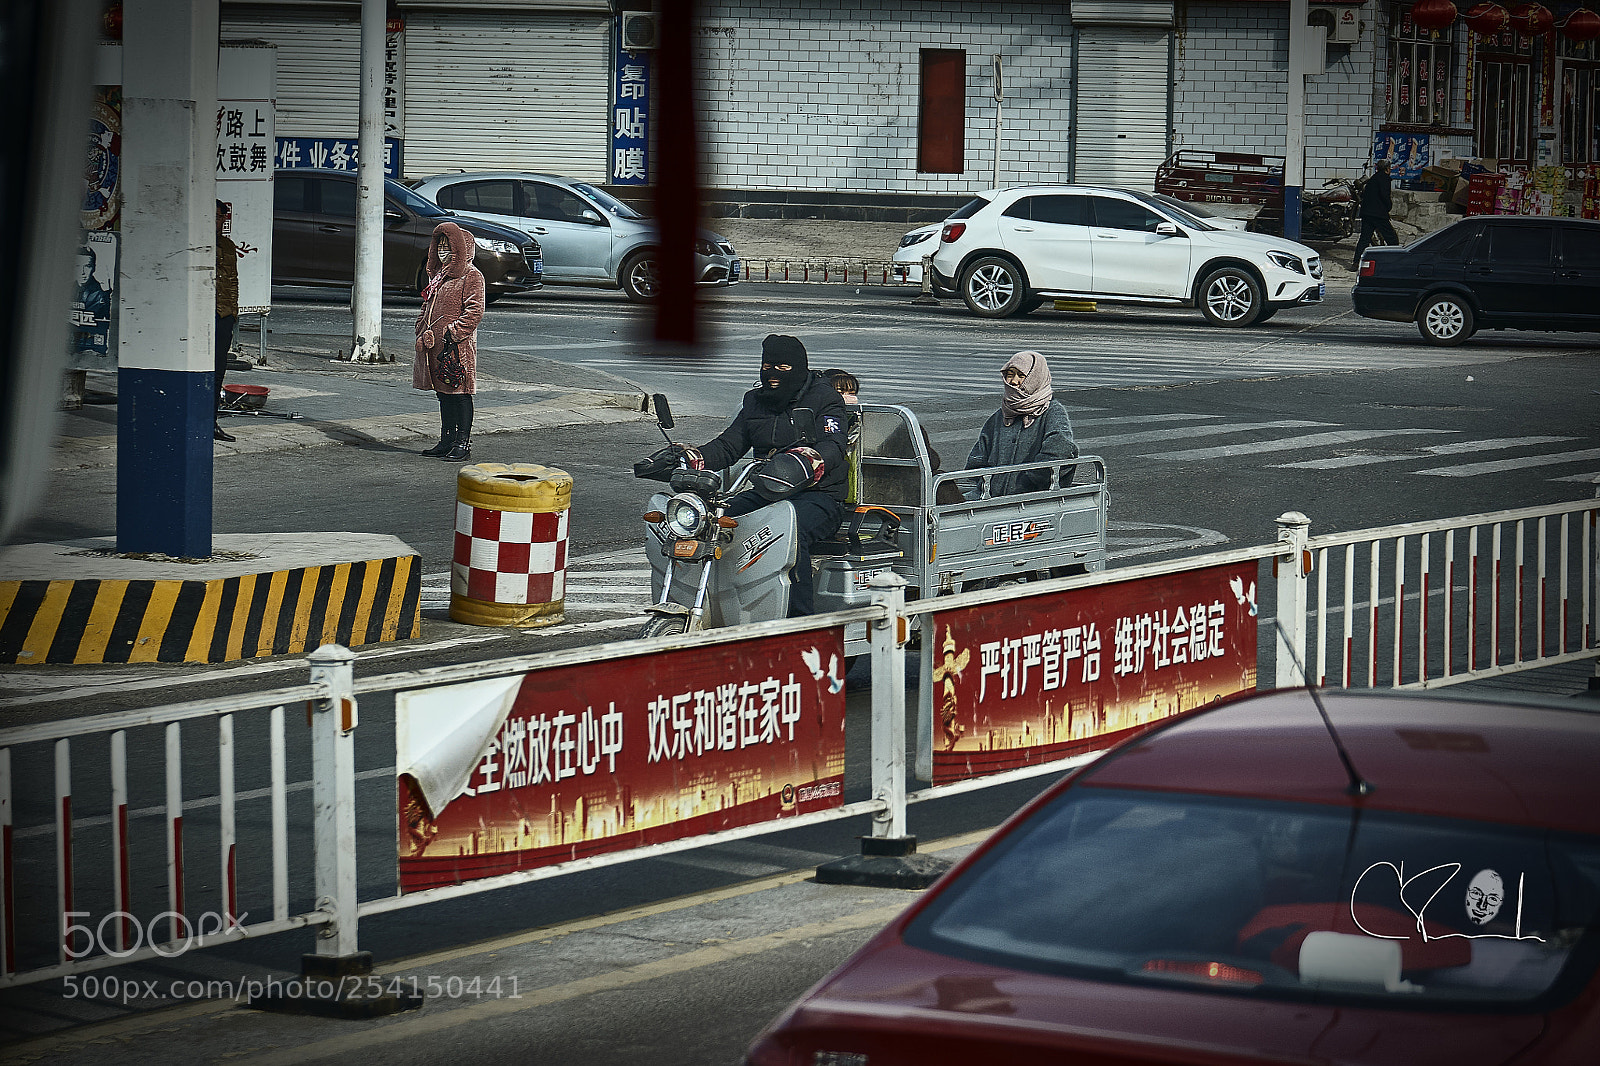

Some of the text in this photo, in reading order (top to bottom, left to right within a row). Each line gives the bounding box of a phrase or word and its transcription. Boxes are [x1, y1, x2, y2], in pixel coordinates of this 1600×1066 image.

[979, 599, 1226, 704] 严打严管严治 维护社会稳定
[463, 672, 802, 797] 全燃放在心中 欢乐和谐在家中
